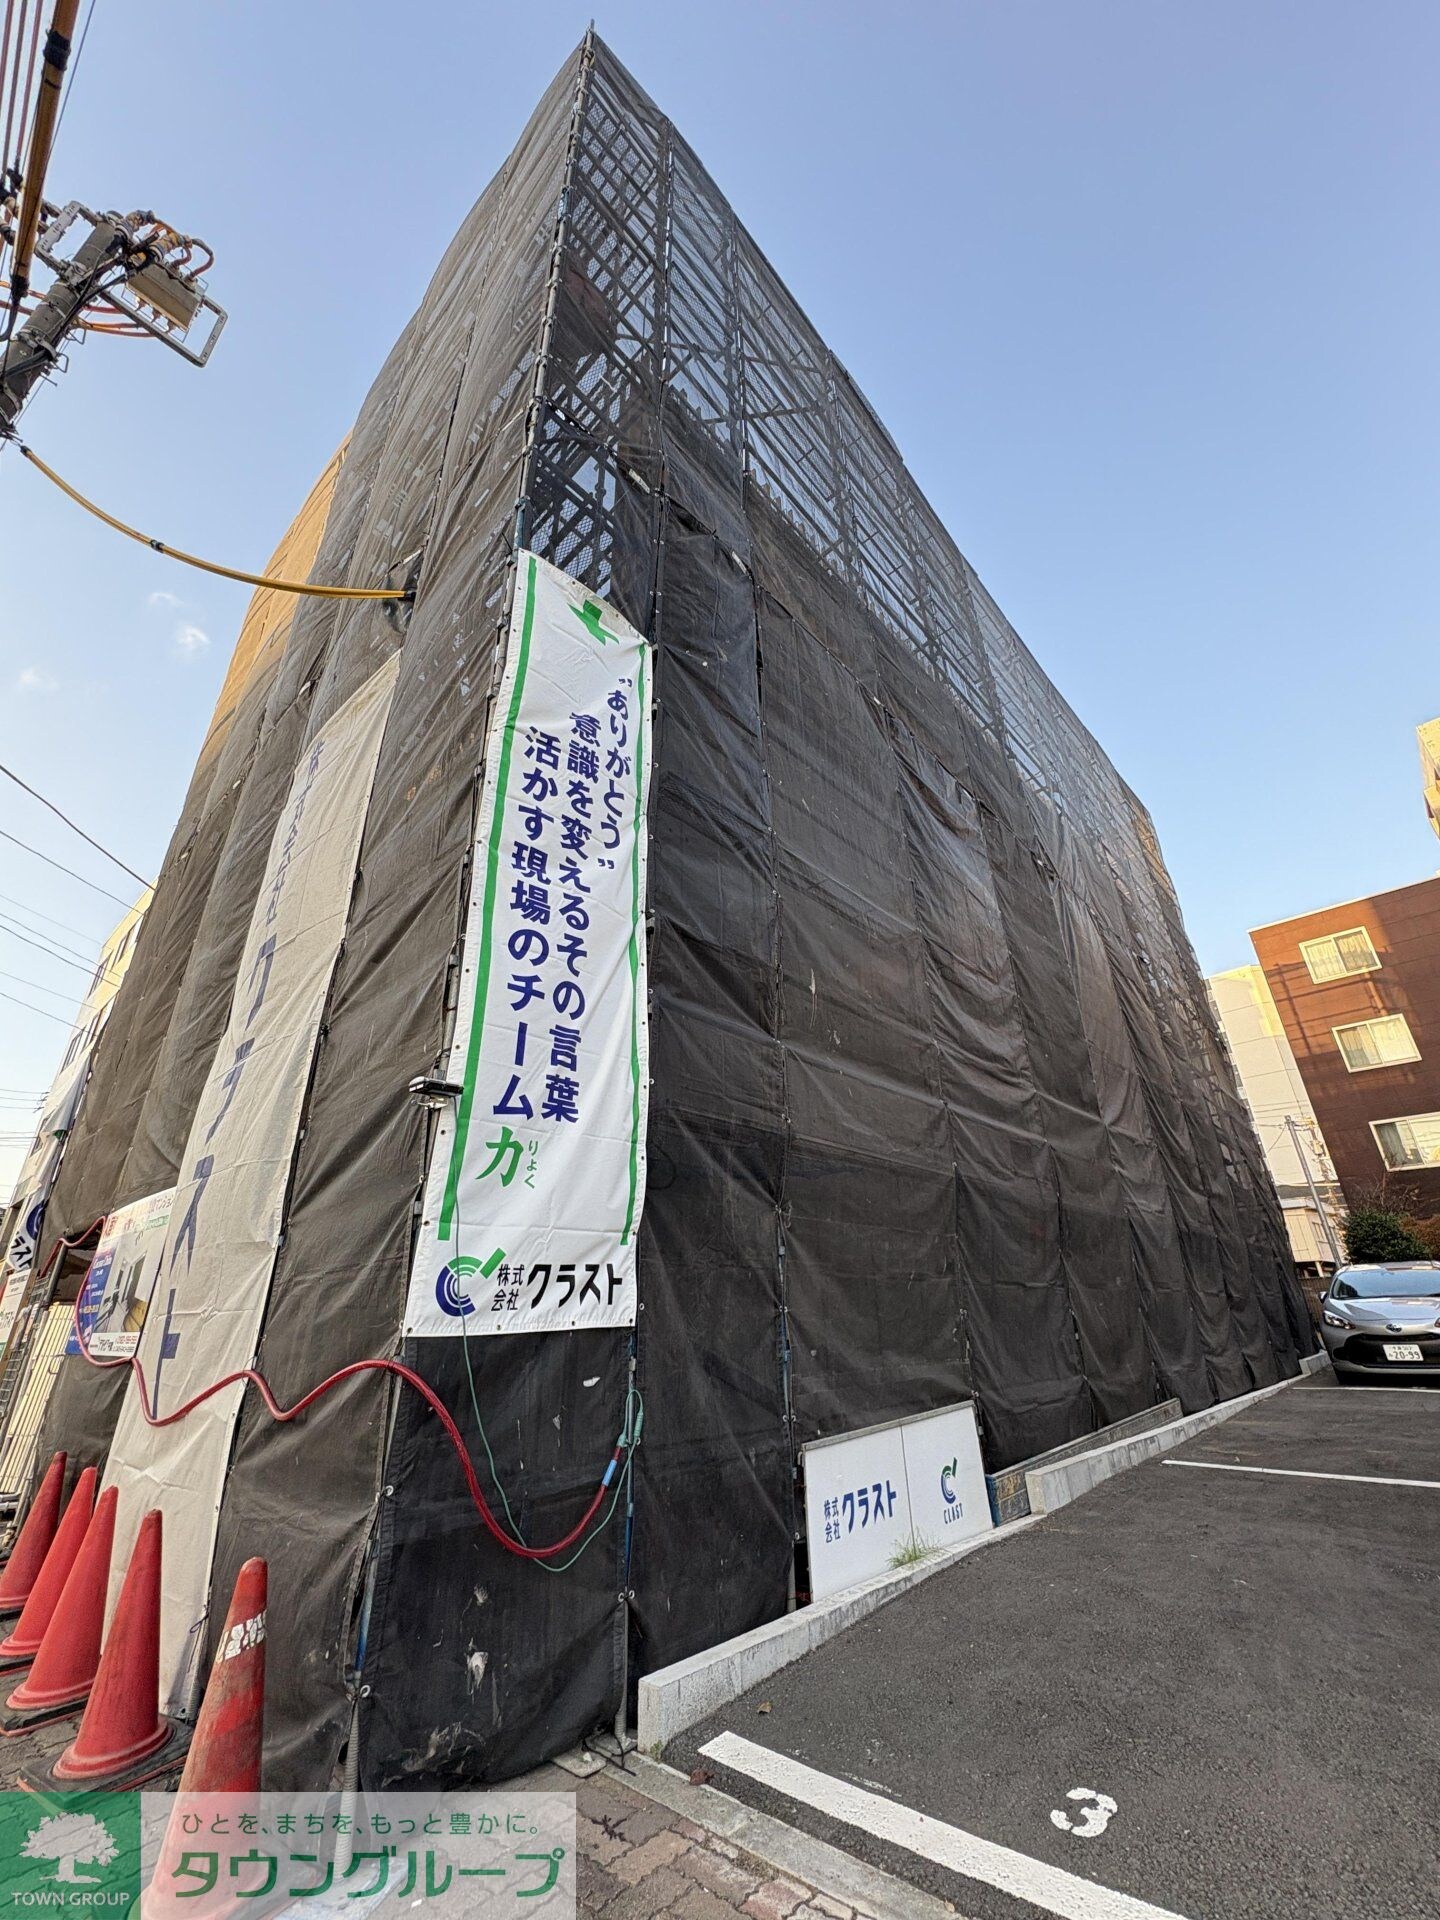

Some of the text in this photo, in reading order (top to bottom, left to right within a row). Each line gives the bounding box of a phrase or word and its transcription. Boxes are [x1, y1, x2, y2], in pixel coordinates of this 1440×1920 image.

[541, 711, 601, 1124] 意識を変えるその言葉
[524, 1140, 539, 1189] りょく
[527, 1263, 622, 1310] クラスト
[841, 1480, 897, 1535] クラスト
[943, 1502, 963, 1525] CLAST
[1050, 1787, 1118, 1838] 3
